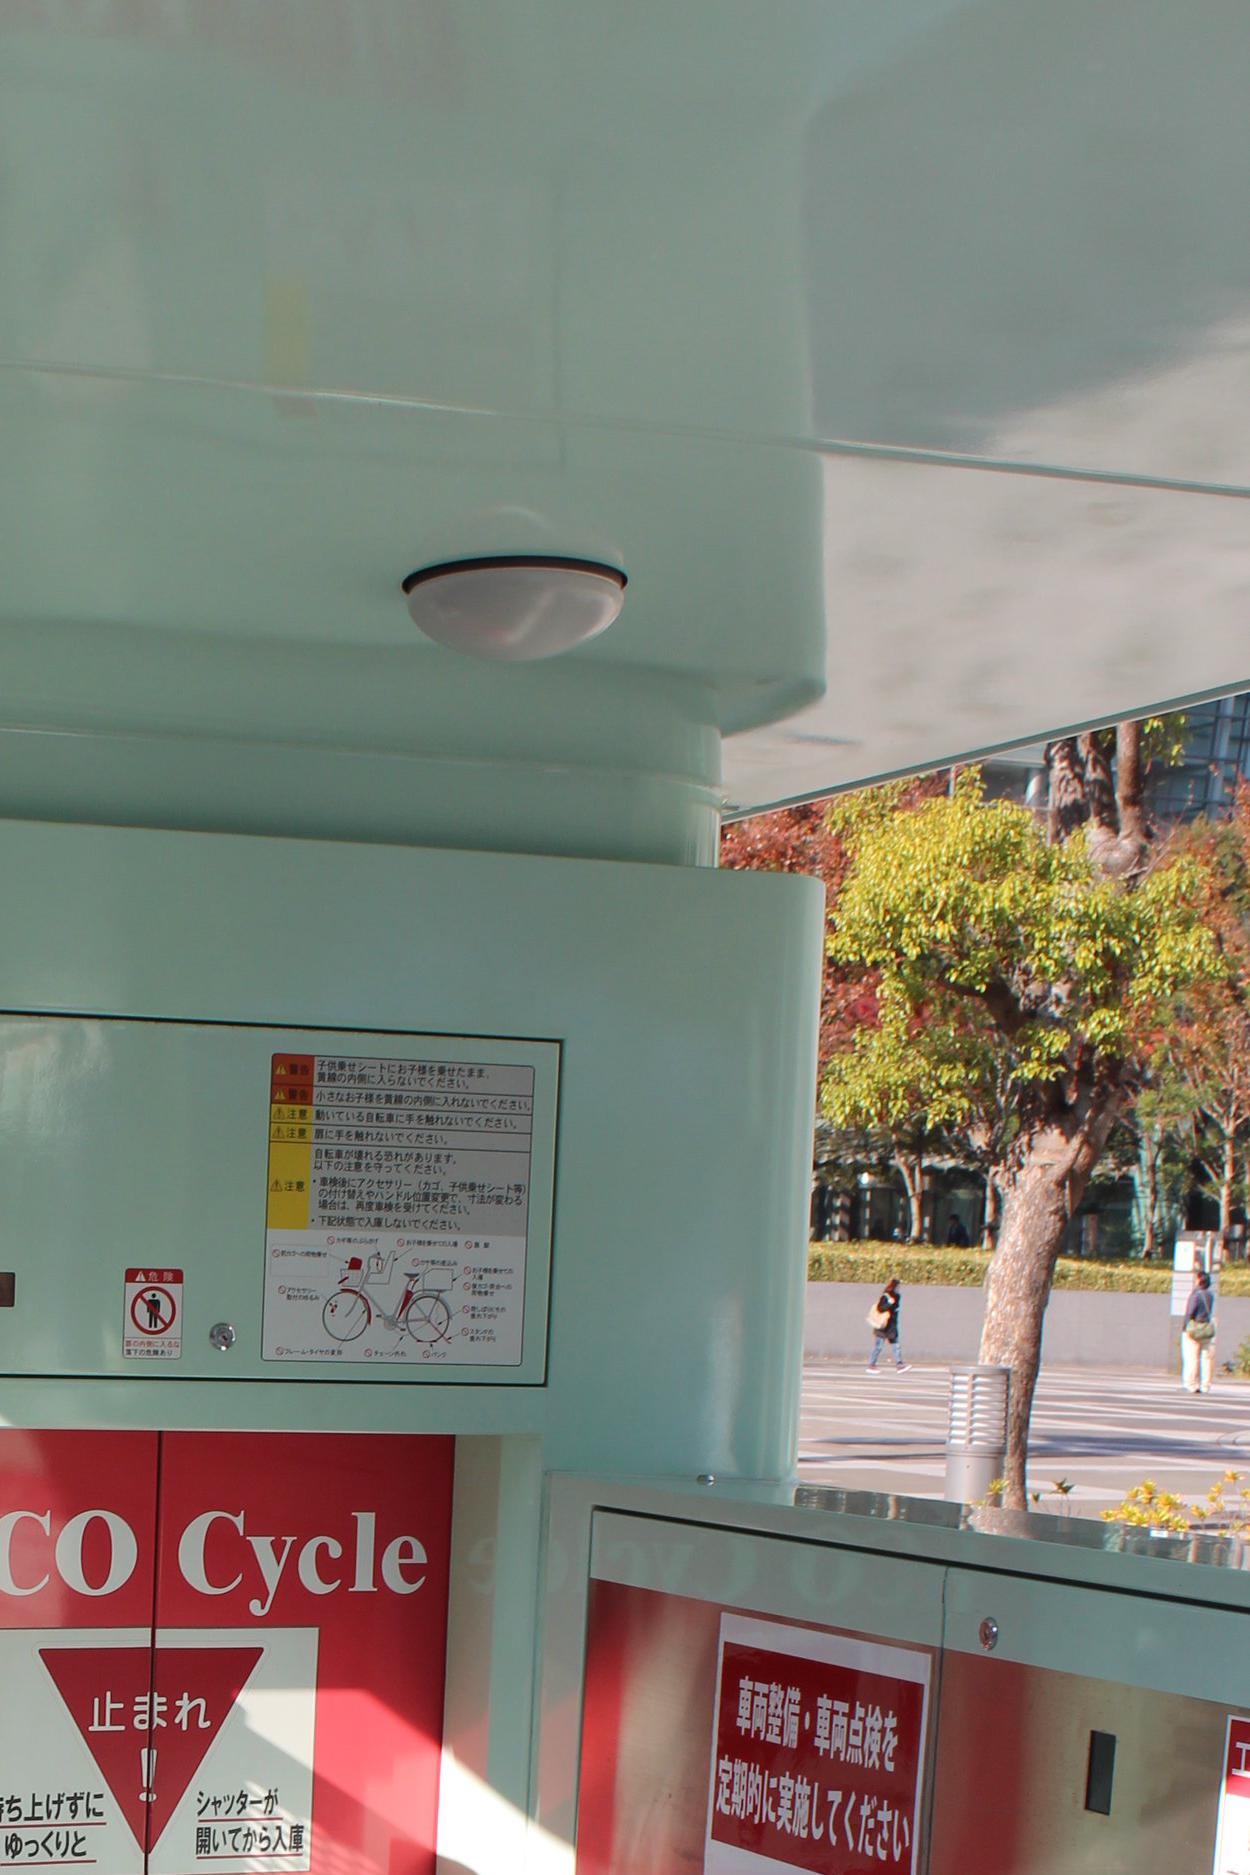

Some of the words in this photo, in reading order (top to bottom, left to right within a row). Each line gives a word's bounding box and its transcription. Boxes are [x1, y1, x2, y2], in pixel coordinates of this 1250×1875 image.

[286, 1109, 308, 1120] 注意
[286, 1128, 307, 1140] 注意
[284, 1180, 305, 1192] 注意
[178, 1510, 428, 1616] Cycle
[87, 1690, 212, 1734] 止まれ
[736, 1675, 898, 1772] 車両整備・車両点検を
[196, 1788, 280, 1818] シャッターが
[715, 1756, 911, 1862] 定期的に実施してください
[4, 1829, 88, 1859] ゆっくりと
[195, 1823, 305, 1855] 開いてから入庫
